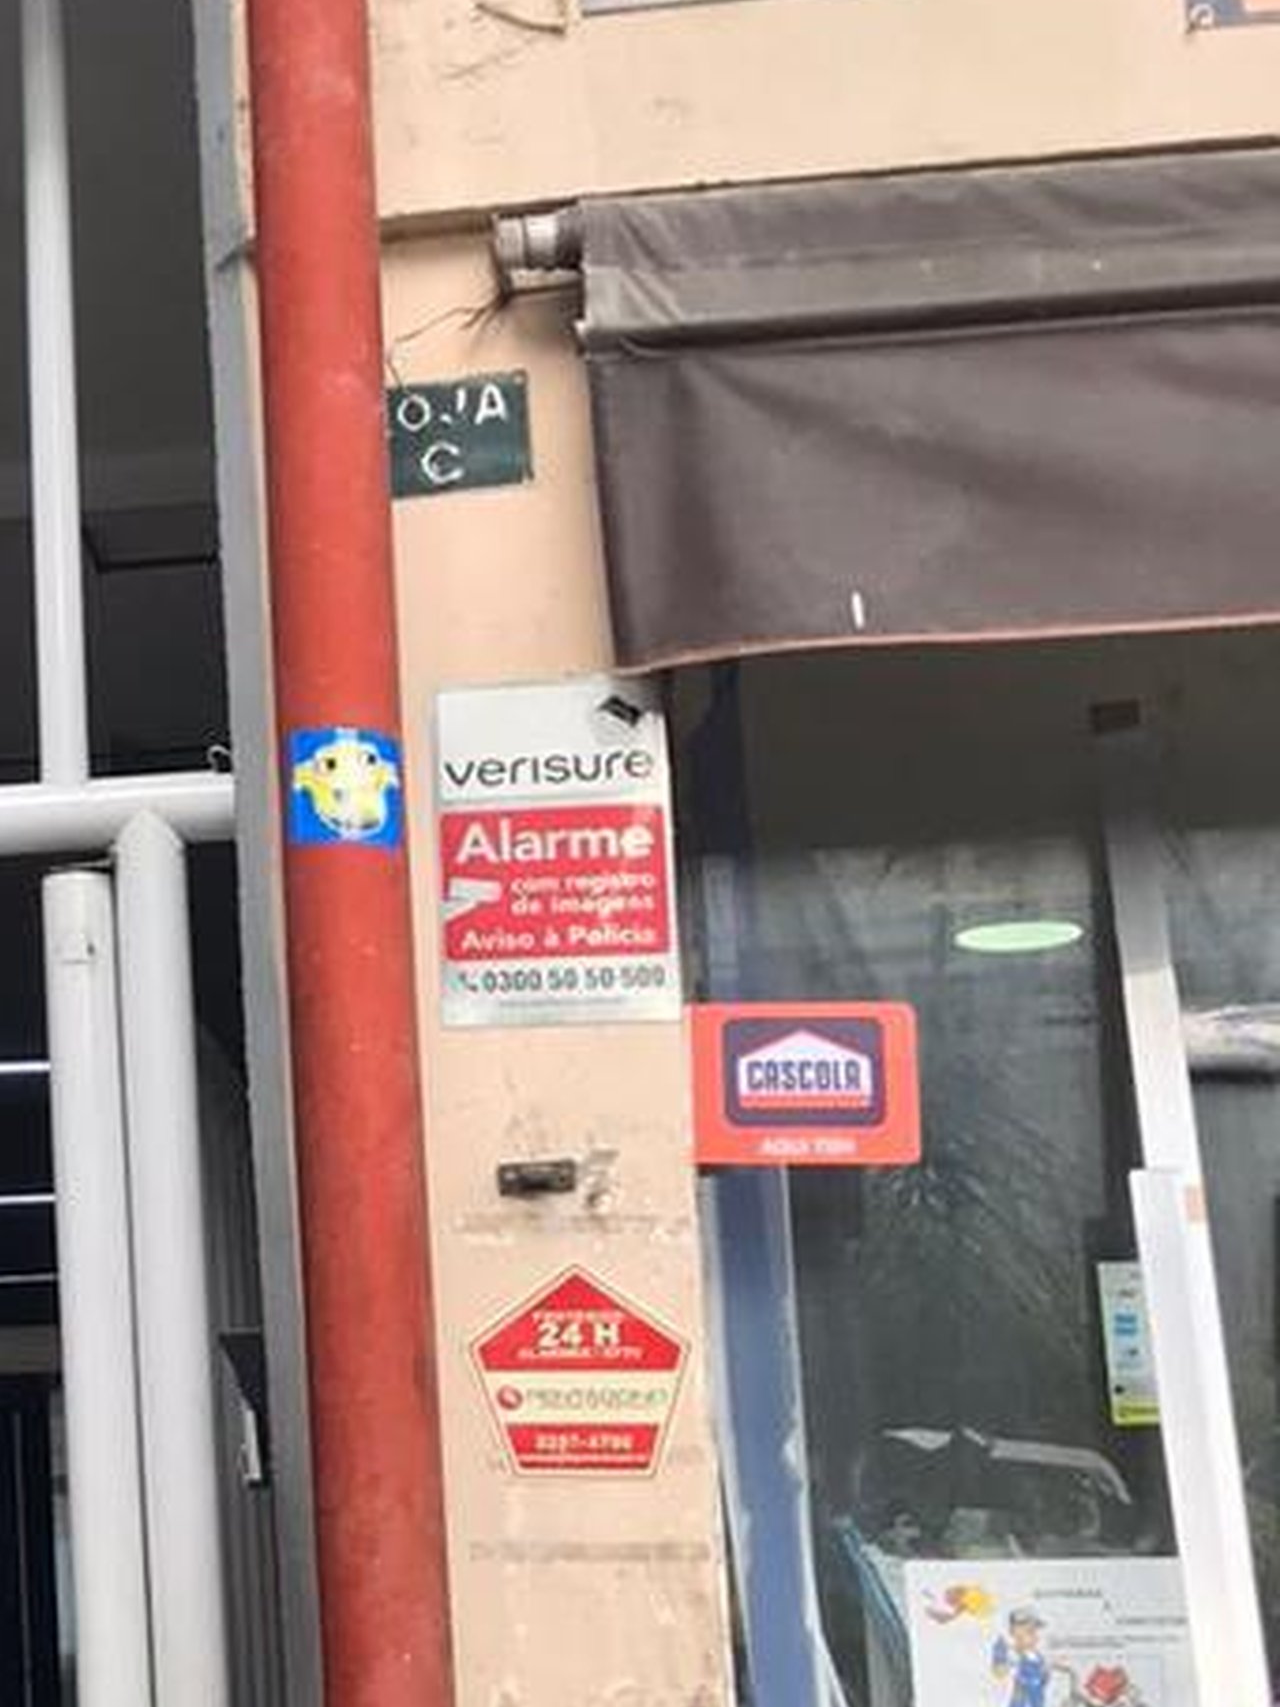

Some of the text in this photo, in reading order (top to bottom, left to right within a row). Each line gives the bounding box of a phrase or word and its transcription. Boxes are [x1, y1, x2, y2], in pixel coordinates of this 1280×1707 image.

[444, 750, 654, 786] verisure
[456, 818, 654, 864] Alarme
[510, 896, 542, 916] de
[460, 927, 535, 953] Aviso
[481, 968, 541, 993] 0300
[746, 1059, 861, 1091] CASCOLA
[537, 1320, 620, 1347] 24 H
